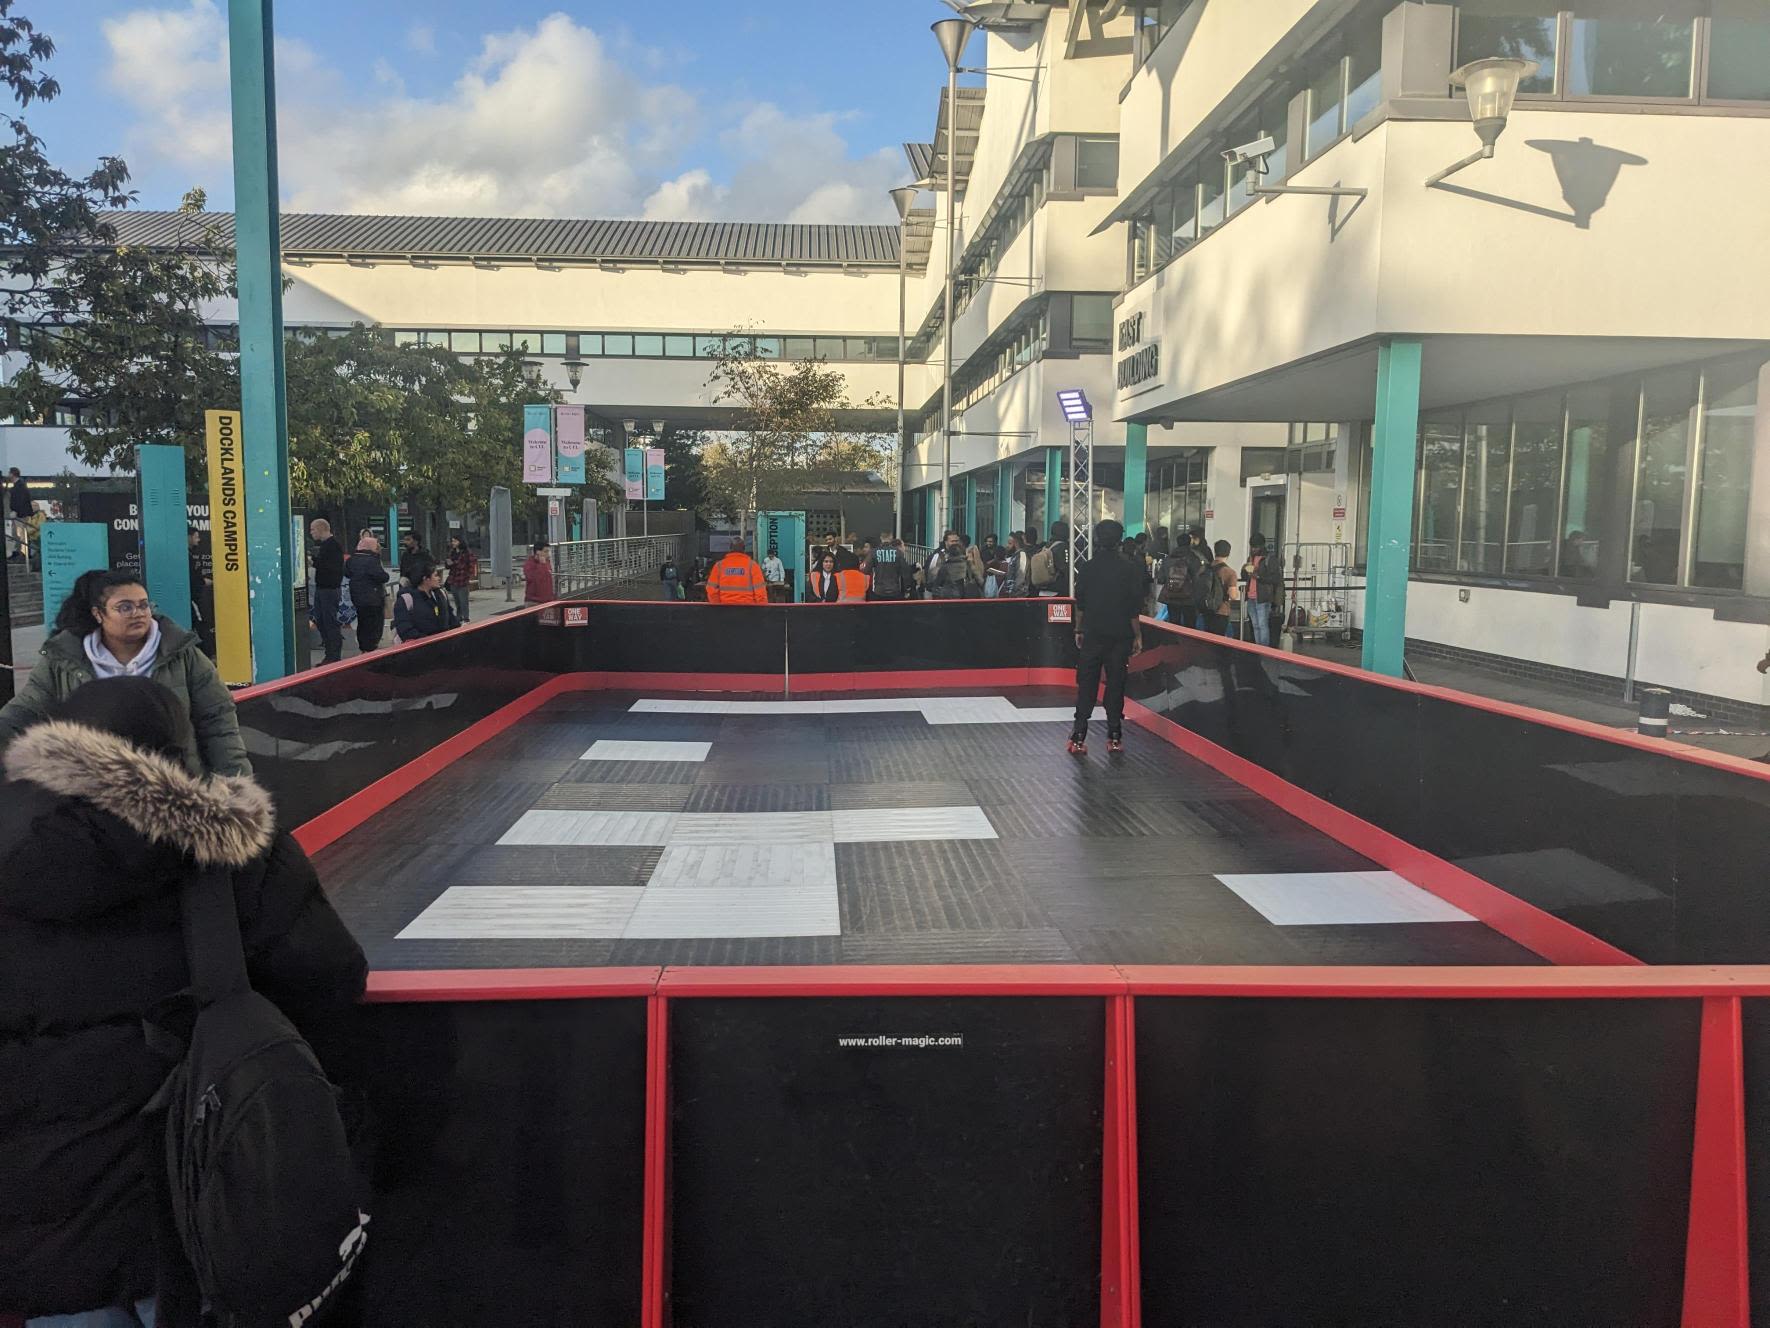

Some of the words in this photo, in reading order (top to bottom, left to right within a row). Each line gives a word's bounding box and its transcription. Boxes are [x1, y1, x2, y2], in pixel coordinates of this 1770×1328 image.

[1118, 311, 1142, 352] EAST
[1117, 343, 1159, 391] BUILDING
[218, 415, 236, 507] DOCKLANDS
[129, 503, 138, 516] B
[113, 518, 139, 531] CON
[187, 519, 212, 531] AM
[222, 509, 239, 572] CAMPUS
[876, 549, 897, 563] STAFF
[839, 1035, 962, 1048] www.roller-magic.com
